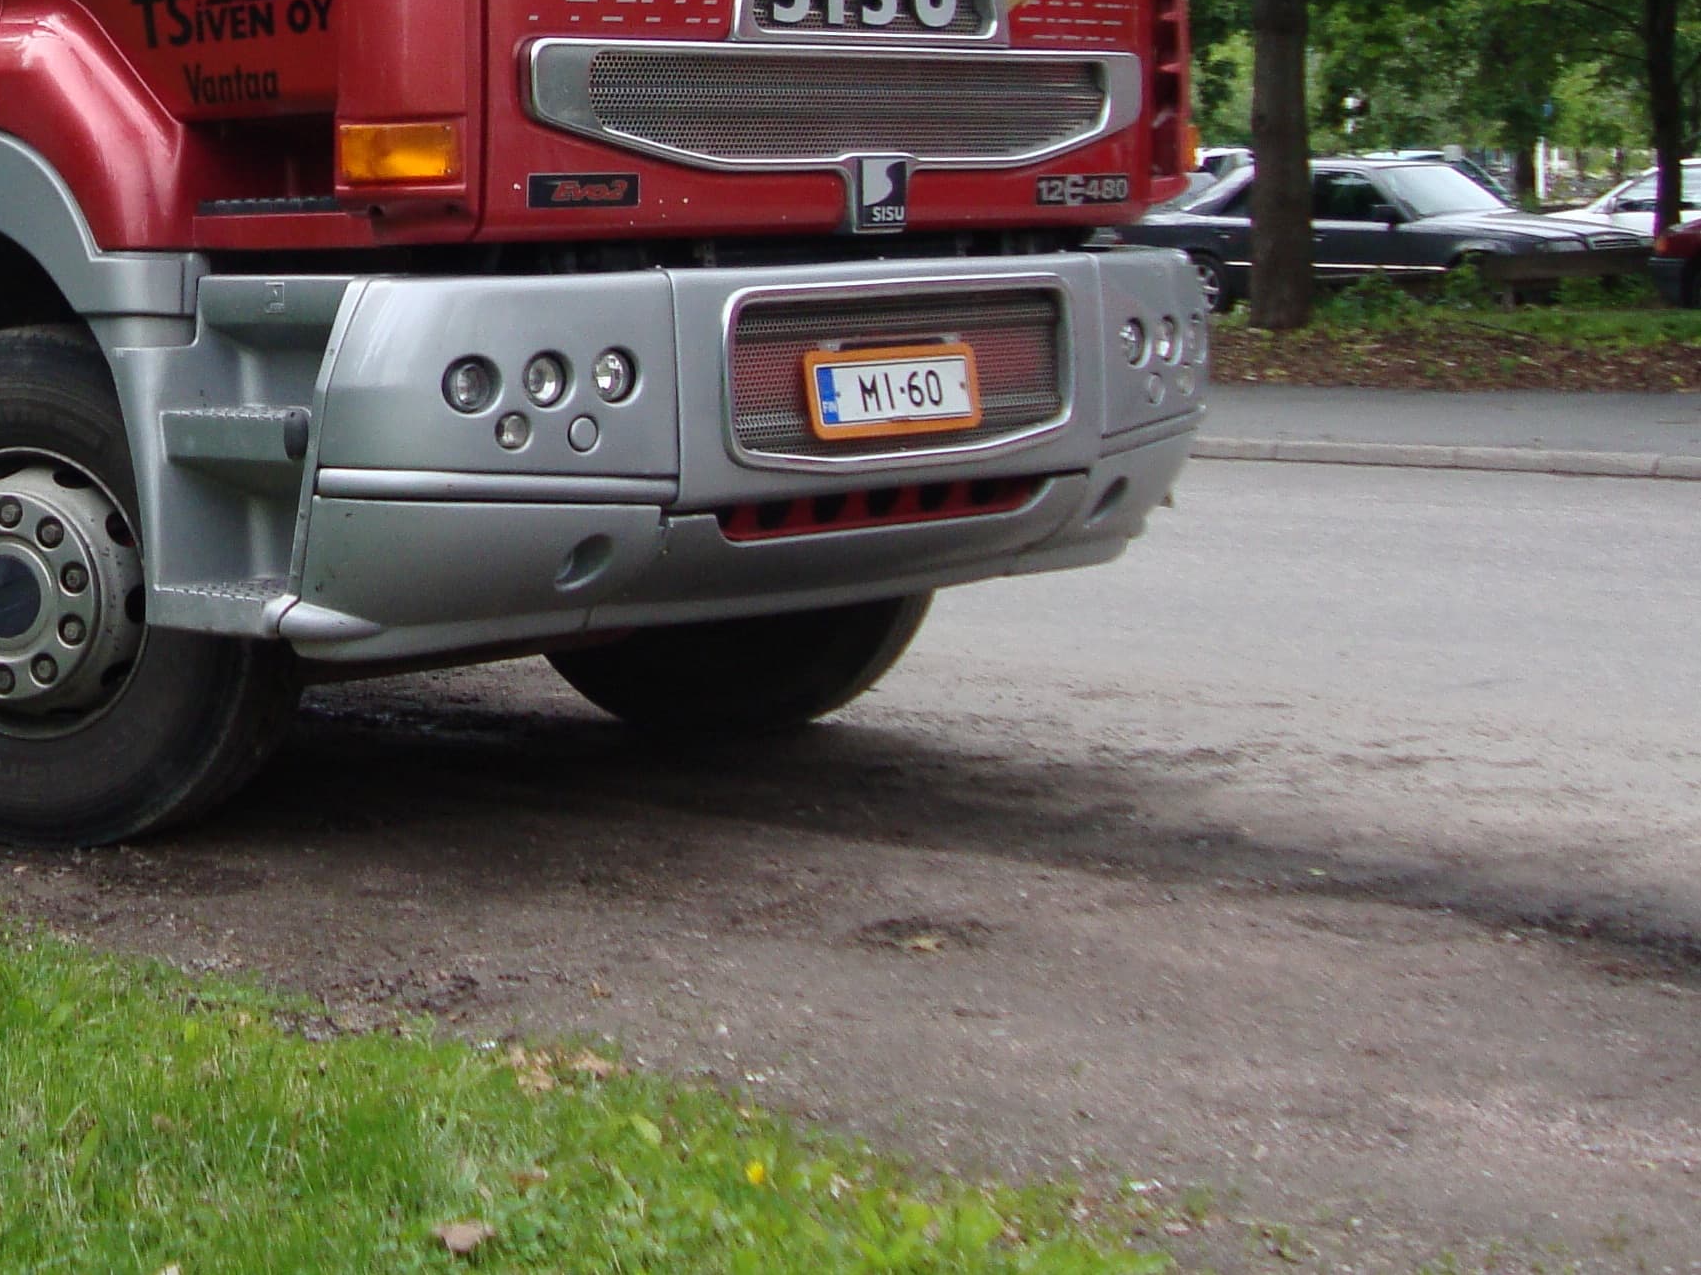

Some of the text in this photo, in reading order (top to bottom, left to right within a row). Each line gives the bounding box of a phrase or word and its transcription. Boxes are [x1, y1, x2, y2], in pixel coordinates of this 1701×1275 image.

[184, 61, 280, 105] Vantaa
[872, 205, 905, 222] SISU
[858, 369, 943, 413] MI-60
